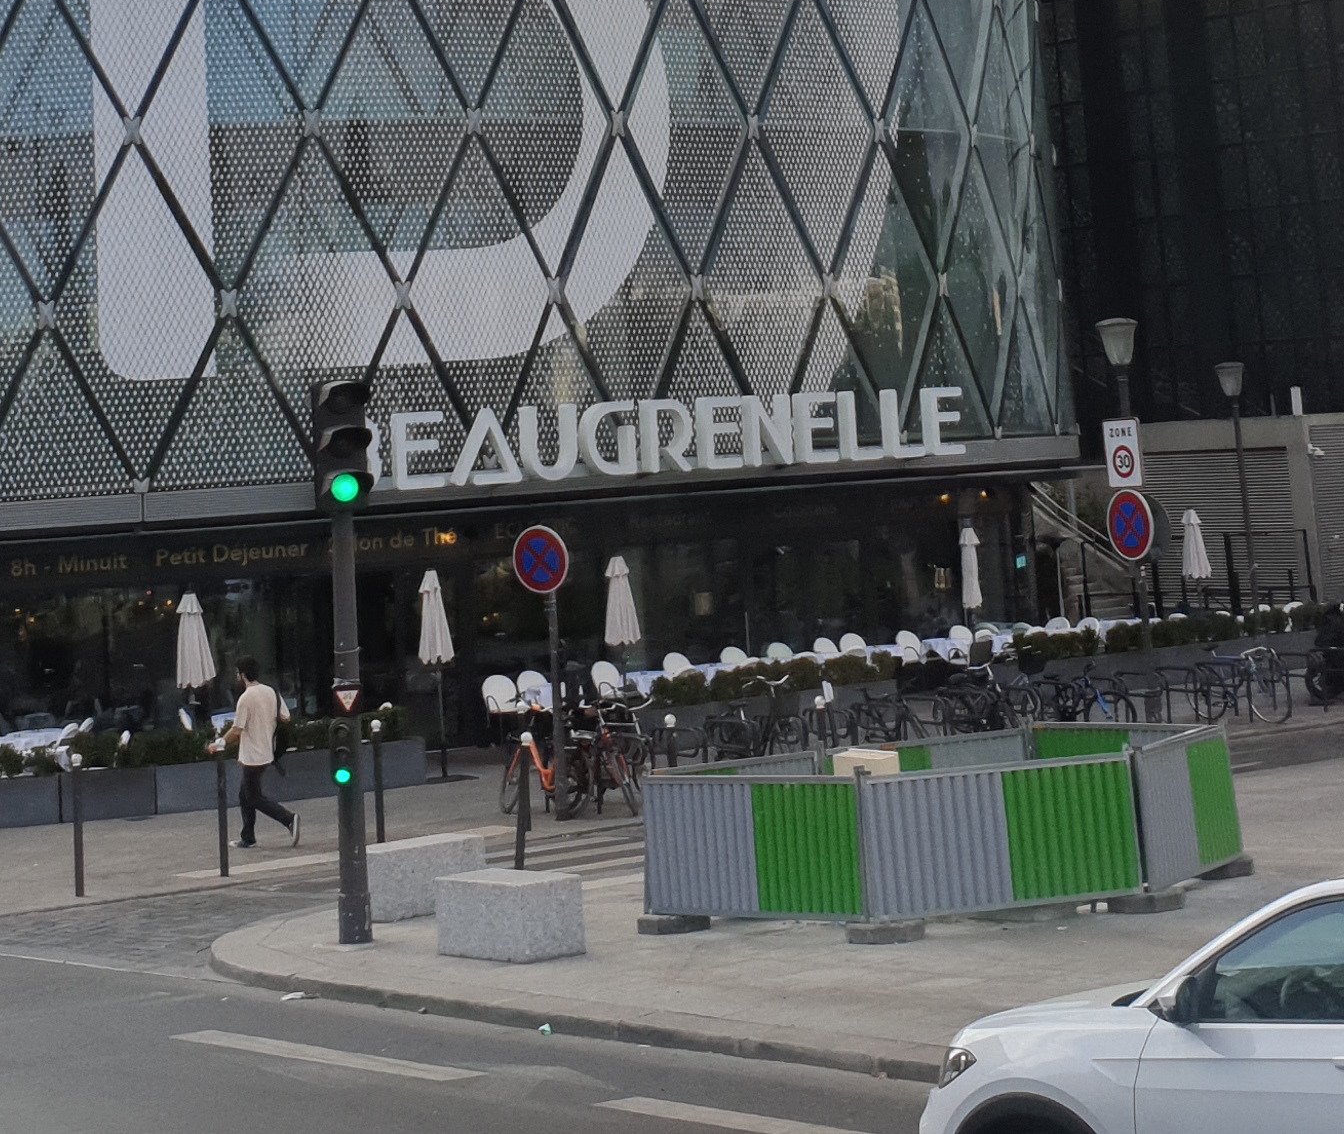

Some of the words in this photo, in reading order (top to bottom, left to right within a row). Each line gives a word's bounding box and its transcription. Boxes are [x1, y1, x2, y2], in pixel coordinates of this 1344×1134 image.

[365, 386, 966, 491] EAUGRENELLE
[1109, 426, 1132, 438] ZONE
[1117, 454, 1131, 469] 30
[10, 558, 36, 577] 8h
[58, 553, 127, 574] Minuit
[156, 546, 206, 566] Petit
[212, 541, 309, 566] Déjeuner
[389, 528, 415, 549] de
[421, 526, 457, 546] Thé
